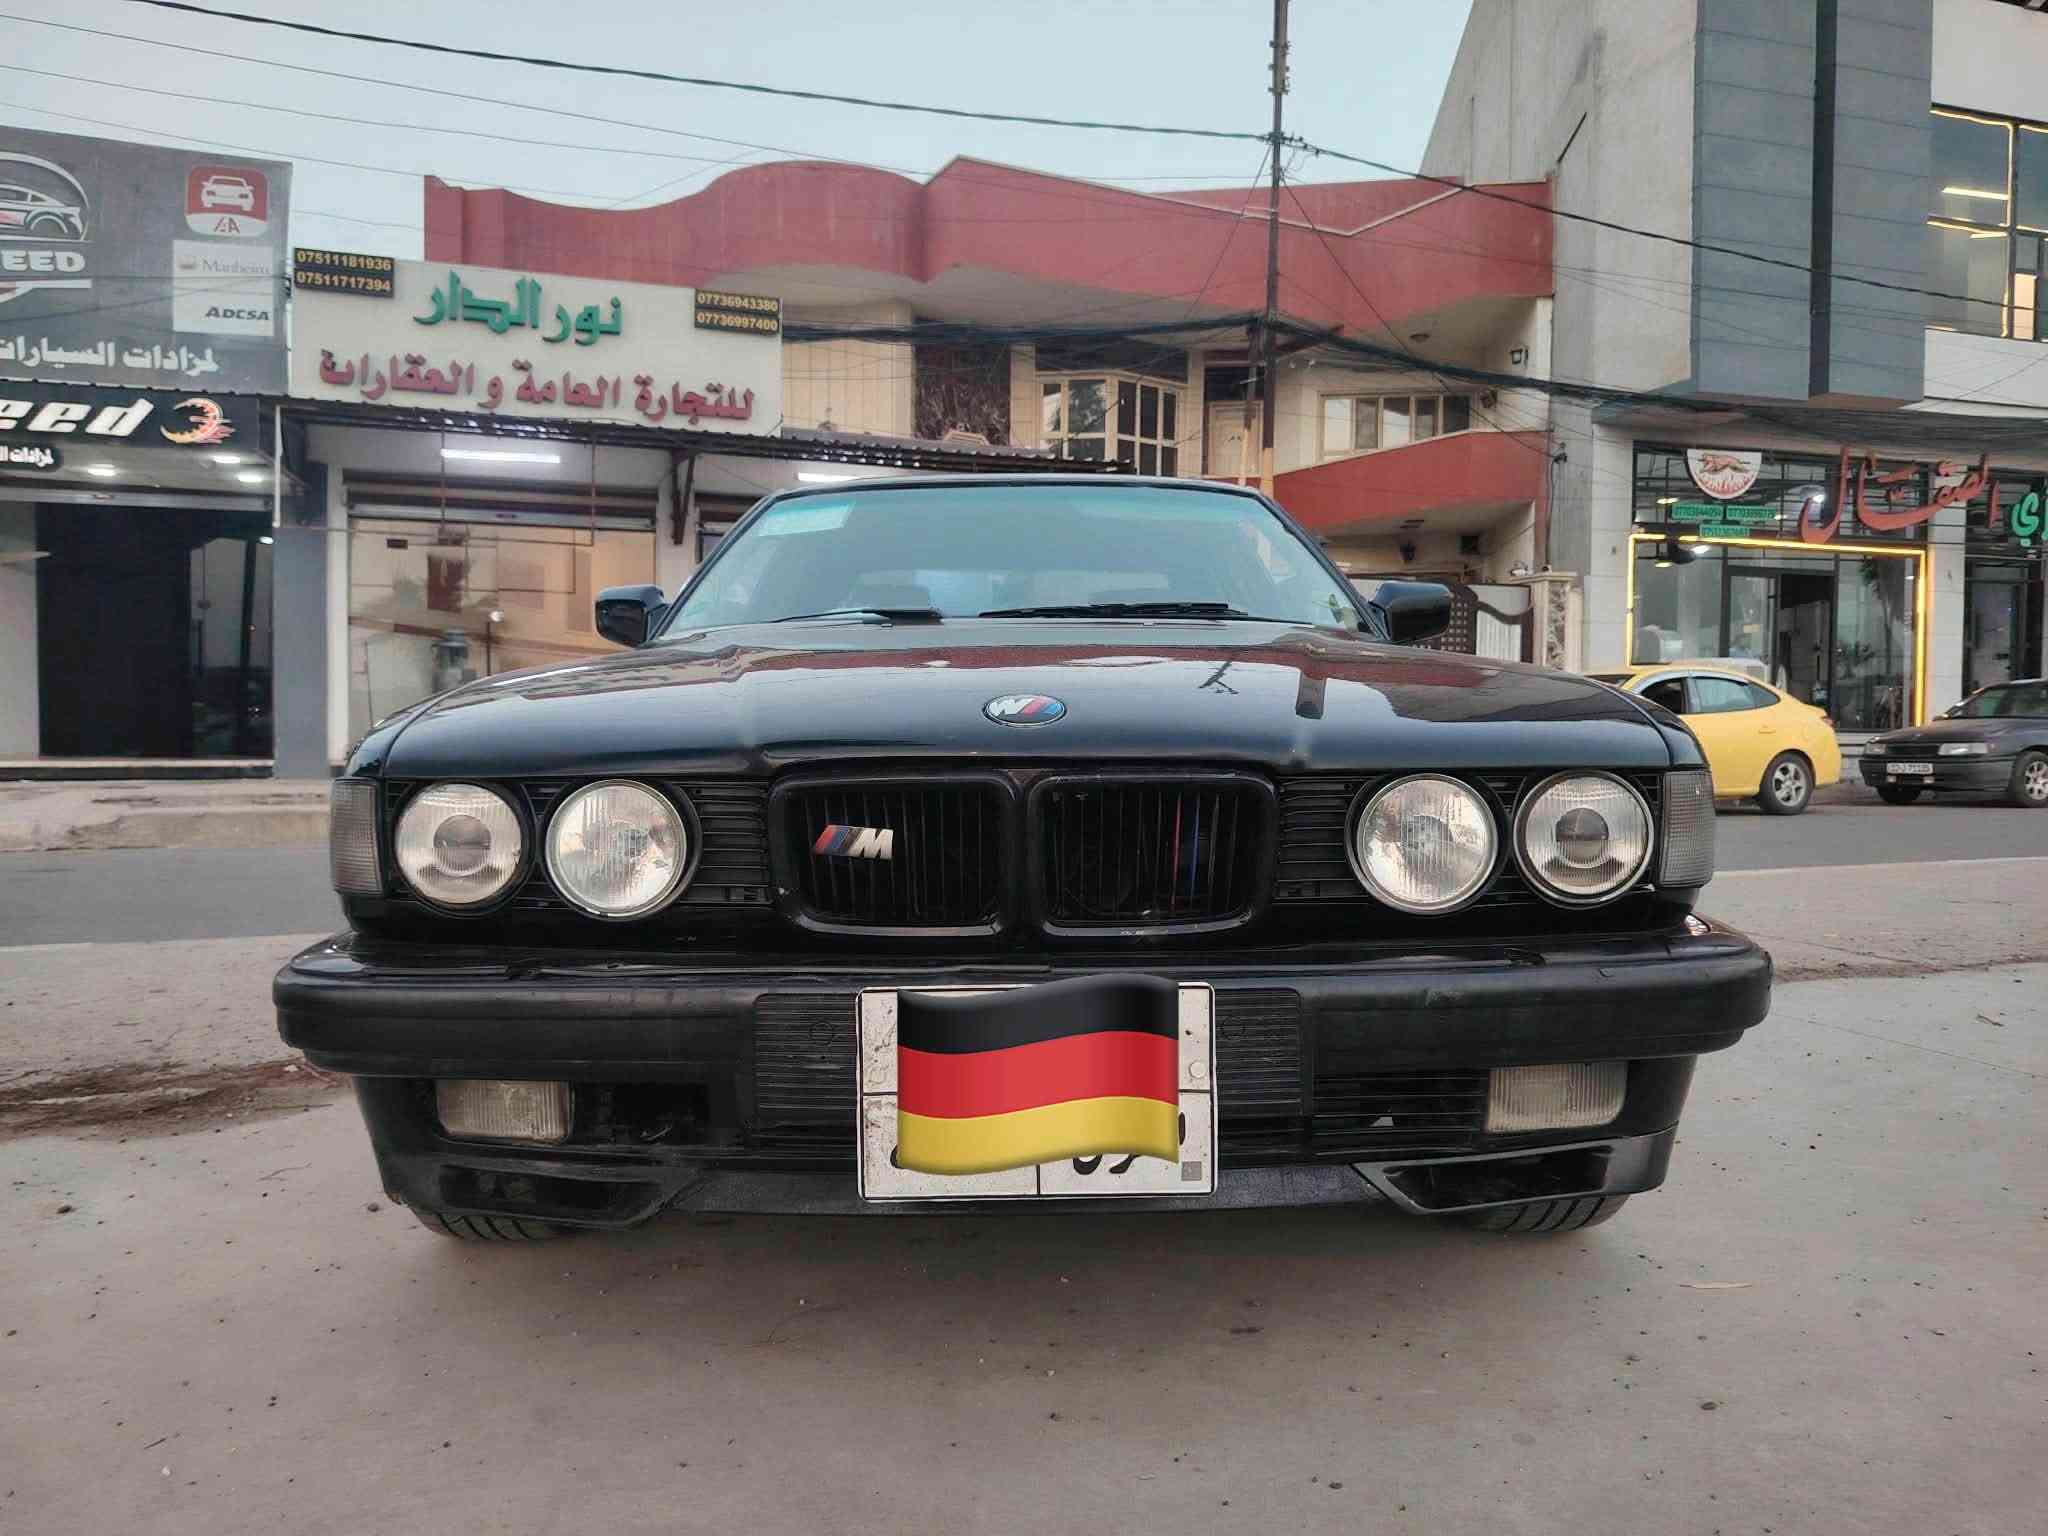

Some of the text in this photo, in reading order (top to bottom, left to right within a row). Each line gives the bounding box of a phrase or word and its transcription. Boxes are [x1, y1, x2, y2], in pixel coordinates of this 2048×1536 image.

[205, 306, 270, 321] ADCSA
[412, 269, 624, 347] نور الدار
[477, 375, 504, 410] و
[511, 358, 622, 409] العامة
[633, 374, 755, 425] للتجارة
